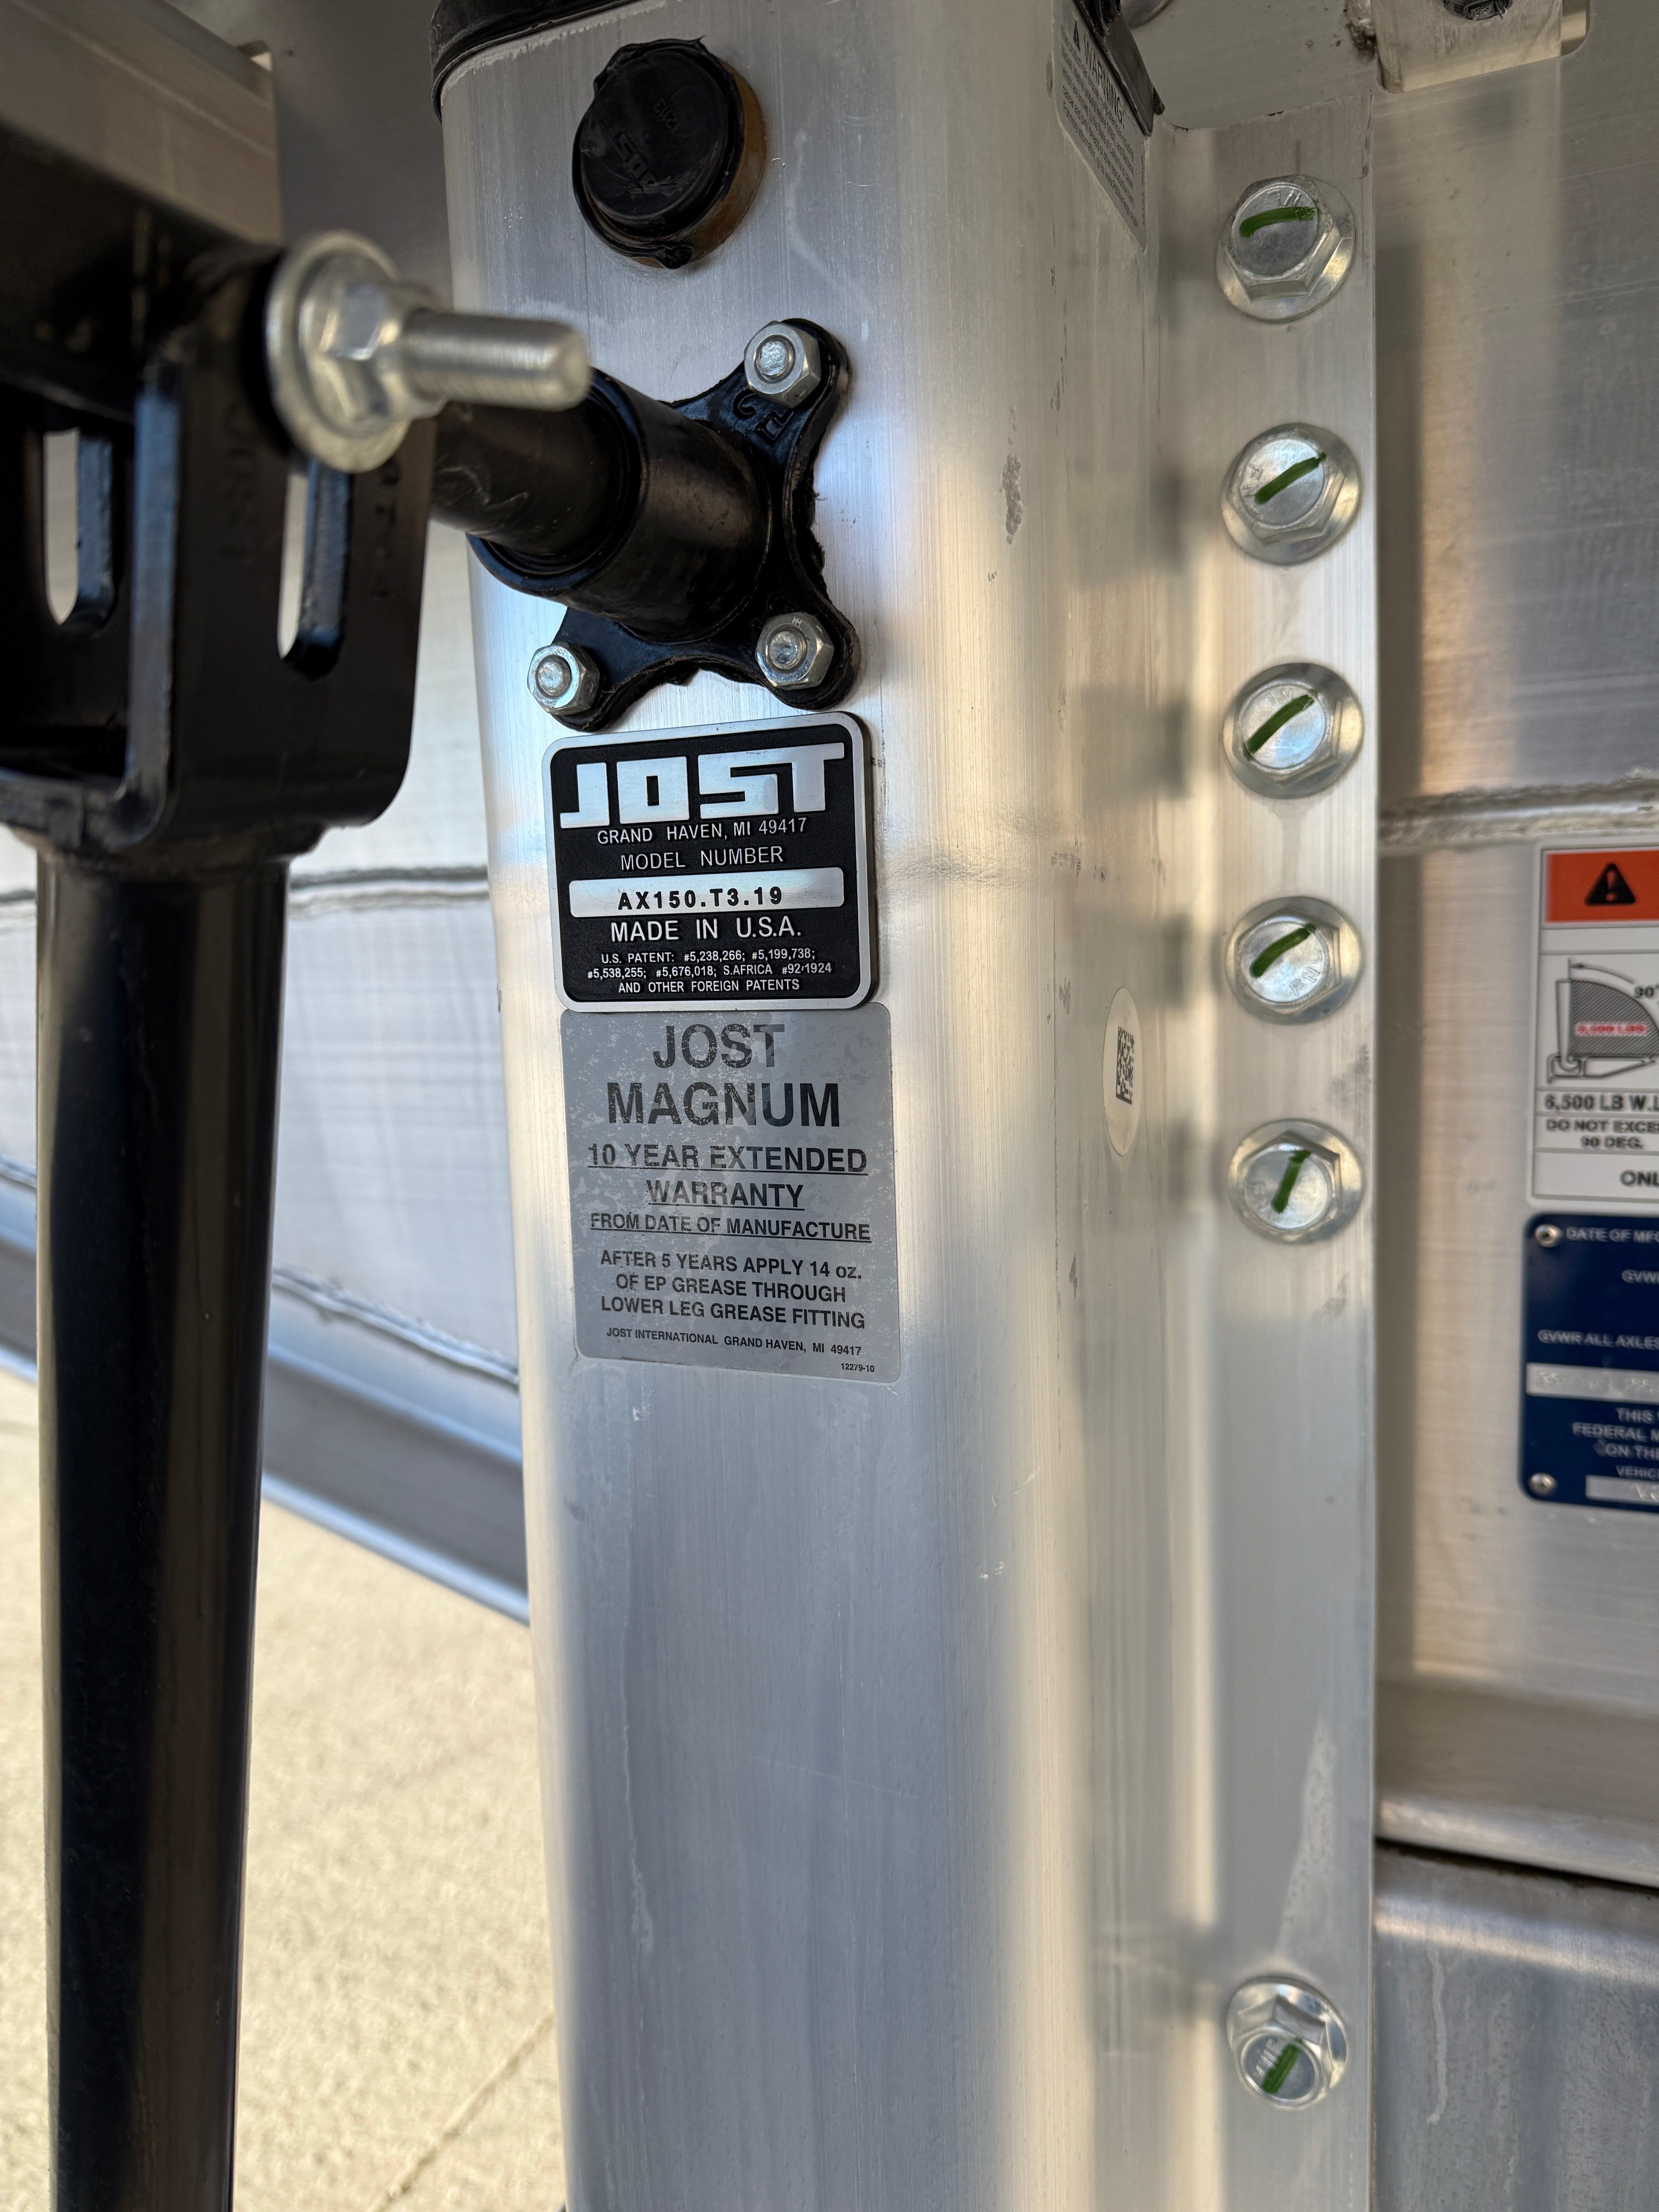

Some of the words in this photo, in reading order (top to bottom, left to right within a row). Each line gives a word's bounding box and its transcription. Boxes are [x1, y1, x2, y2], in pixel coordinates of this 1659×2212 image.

[560, 742, 844, 829] JOST
[598, 828, 653, 844] GRAND
[667, 824, 727, 841] HAVEN,
[734, 822, 750, 837] MI
[759, 818, 807, 835] 49417
[621, 852, 685, 871] MODEL
[701, 846, 783, 866] NUMBER
[618, 887, 782, 910] AX150.T3.19
[611, 921, 678, 943] MADE
[697, 919, 717, 939] IN
[736, 916, 802, 939] U.S.A.
[601, 953, 621, 963] U.S.
[628, 951, 674, 963] PATENT:
[684, 950, 745, 962] #5,238,266;
[752, 949, 815, 960] #5,199,738;
[587, 967, 646, 979] #5,538,255;
[656, 966, 717, 978] #5,676,018;
[723, 964, 772, 976] S.AFRICA
[619, 981, 641, 993] AND
[648, 981, 684, 993] OTHER
[691, 980, 739, 992] FOREIGN
[746, 979, 799, 991] PATENTS
[653, 1024, 785, 1068] JOST
[607, 1082, 840, 1127] MAGNUM
[1545, 1094, 1594, 1111] 6,500
[1600, 1095, 1624, 1110] LB
[1547, 1120, 1569, 1132] DO
[1574, 1120, 1608, 1132] NOT
[1580, 1136, 1600, 1147] 90
[589, 1144, 616, 1167] 10
[625, 1144, 698, 1168] YEAR
[710, 1146, 867, 1172] EXTENDED
[647, 1180, 804, 1208] WARRANTY
[591, 1213, 640, 1229] FROM
[645, 1214, 691, 1231] DATE
[697, 1217, 721, 1233] OF
[726, 1218, 871, 1240] MANUFACTURE
[1566, 1227, 1608, 1242] DATE
[1609, 1228, 1632, 1242] OF
[601, 1250, 656, 1267] AFTER
[661, 1254, 671, 1267] 5
[678, 1254, 737, 1272] YEARS
[743, 1257, 803, 1276] APPLY
[810, 1261, 830, 1276] 14
[836, 1265, 862, 1279] oz.
[617, 1274, 639, 1290] OF
[645, 1276, 666, 1291] EP
[672, 1277, 746, 1297] GREASE
[752, 1281, 846, 1303] THROUGH
[601, 1296, 663, 1315] LOWER
[670, 1300, 705, 1317] LEG
[711, 1303, 786, 1322] GREASE
[792, 1308, 865, 1329] FITTING
[607, 1328, 632, 1338] JOST
[635, 1329, 718, 1345] INTERNATIONAL
[724, 1336, 763, 1348] GRAND
[766, 1338, 806, 1353] HAVEN,
[813, 1343, 824, 1353] MI
[831, 1345, 861, 1355] 49417
[1584, 1333, 1615, 1348] ALL
[841, 1363, 874, 1372] 12279-10
[1615, 1408, 1654, 1424] THIS
[1573, 1422, 1649, 1442] FEDERAL
